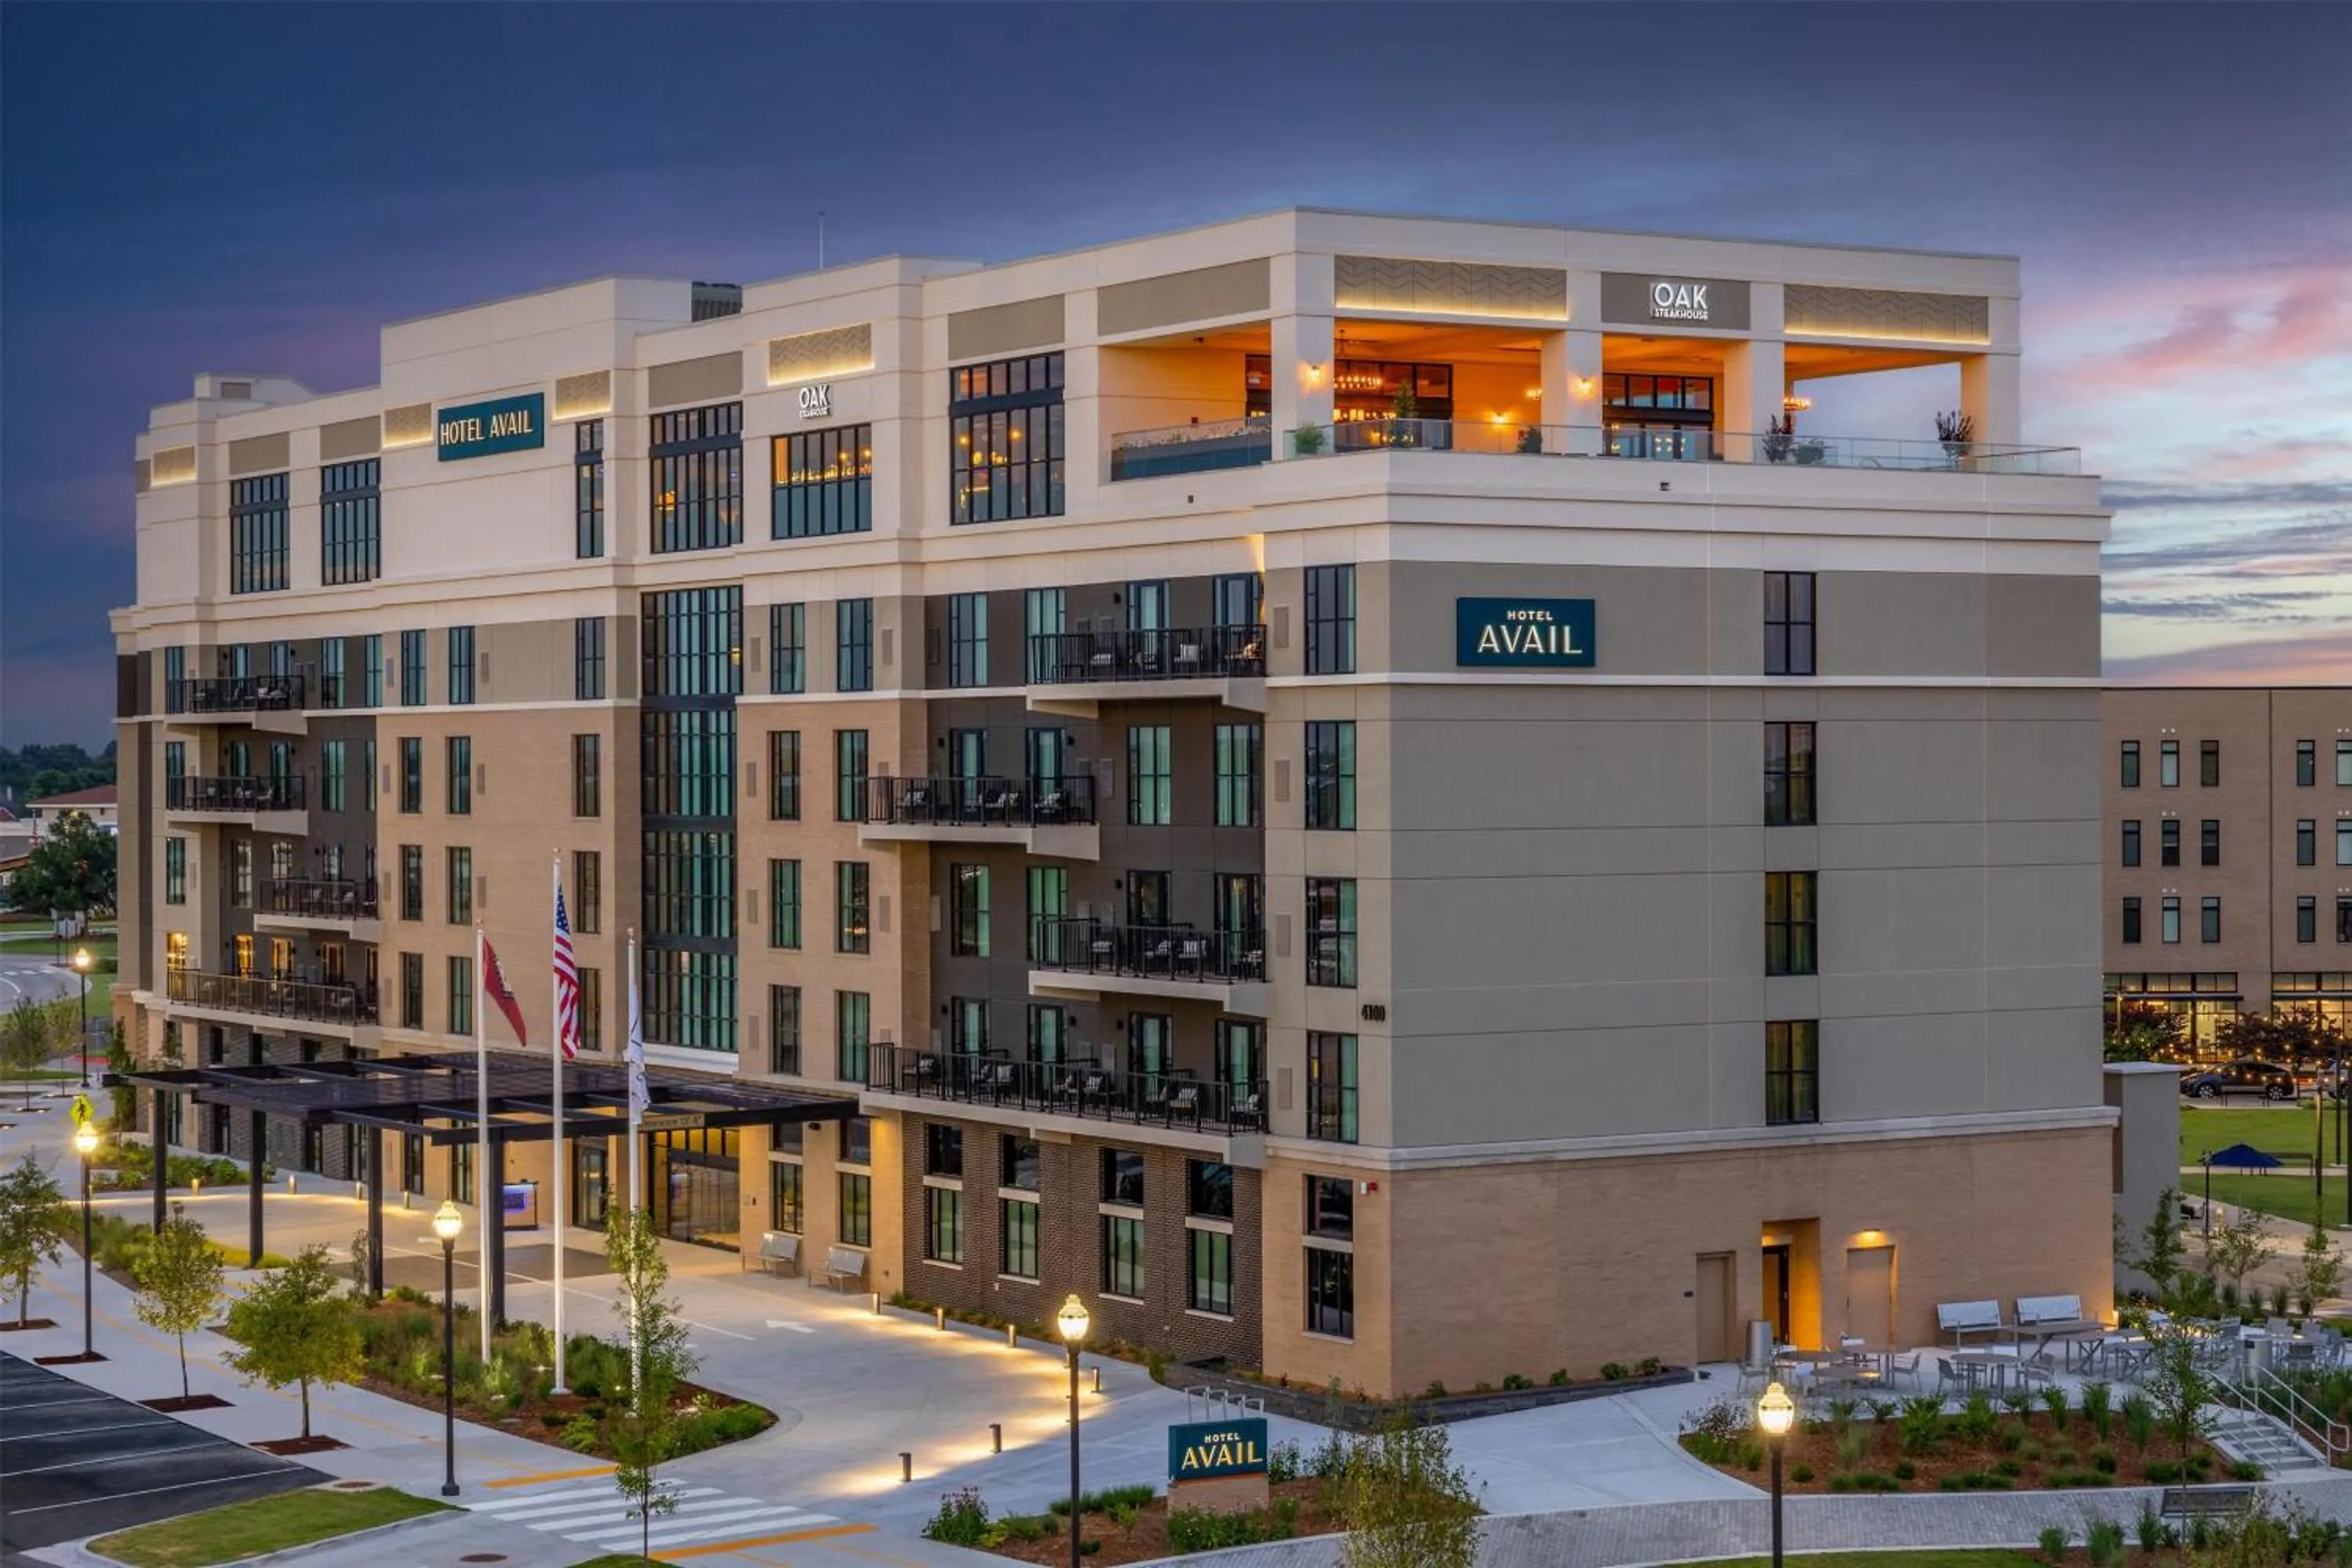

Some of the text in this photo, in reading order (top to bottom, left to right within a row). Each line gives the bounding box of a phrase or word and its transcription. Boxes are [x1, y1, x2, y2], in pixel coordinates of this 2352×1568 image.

[1654, 283, 1707, 309] OAK
[800, 384, 829, 408] OAK
[440, 409, 533, 445] HOTEL AVAIL
[1506, 610, 1553, 621] HOTEL
[1477, 625, 1583, 654] AVAIL
[1204, 1432, 1241, 1443] HOTEL
[1181, 1441, 1263, 1471] AVAIL
